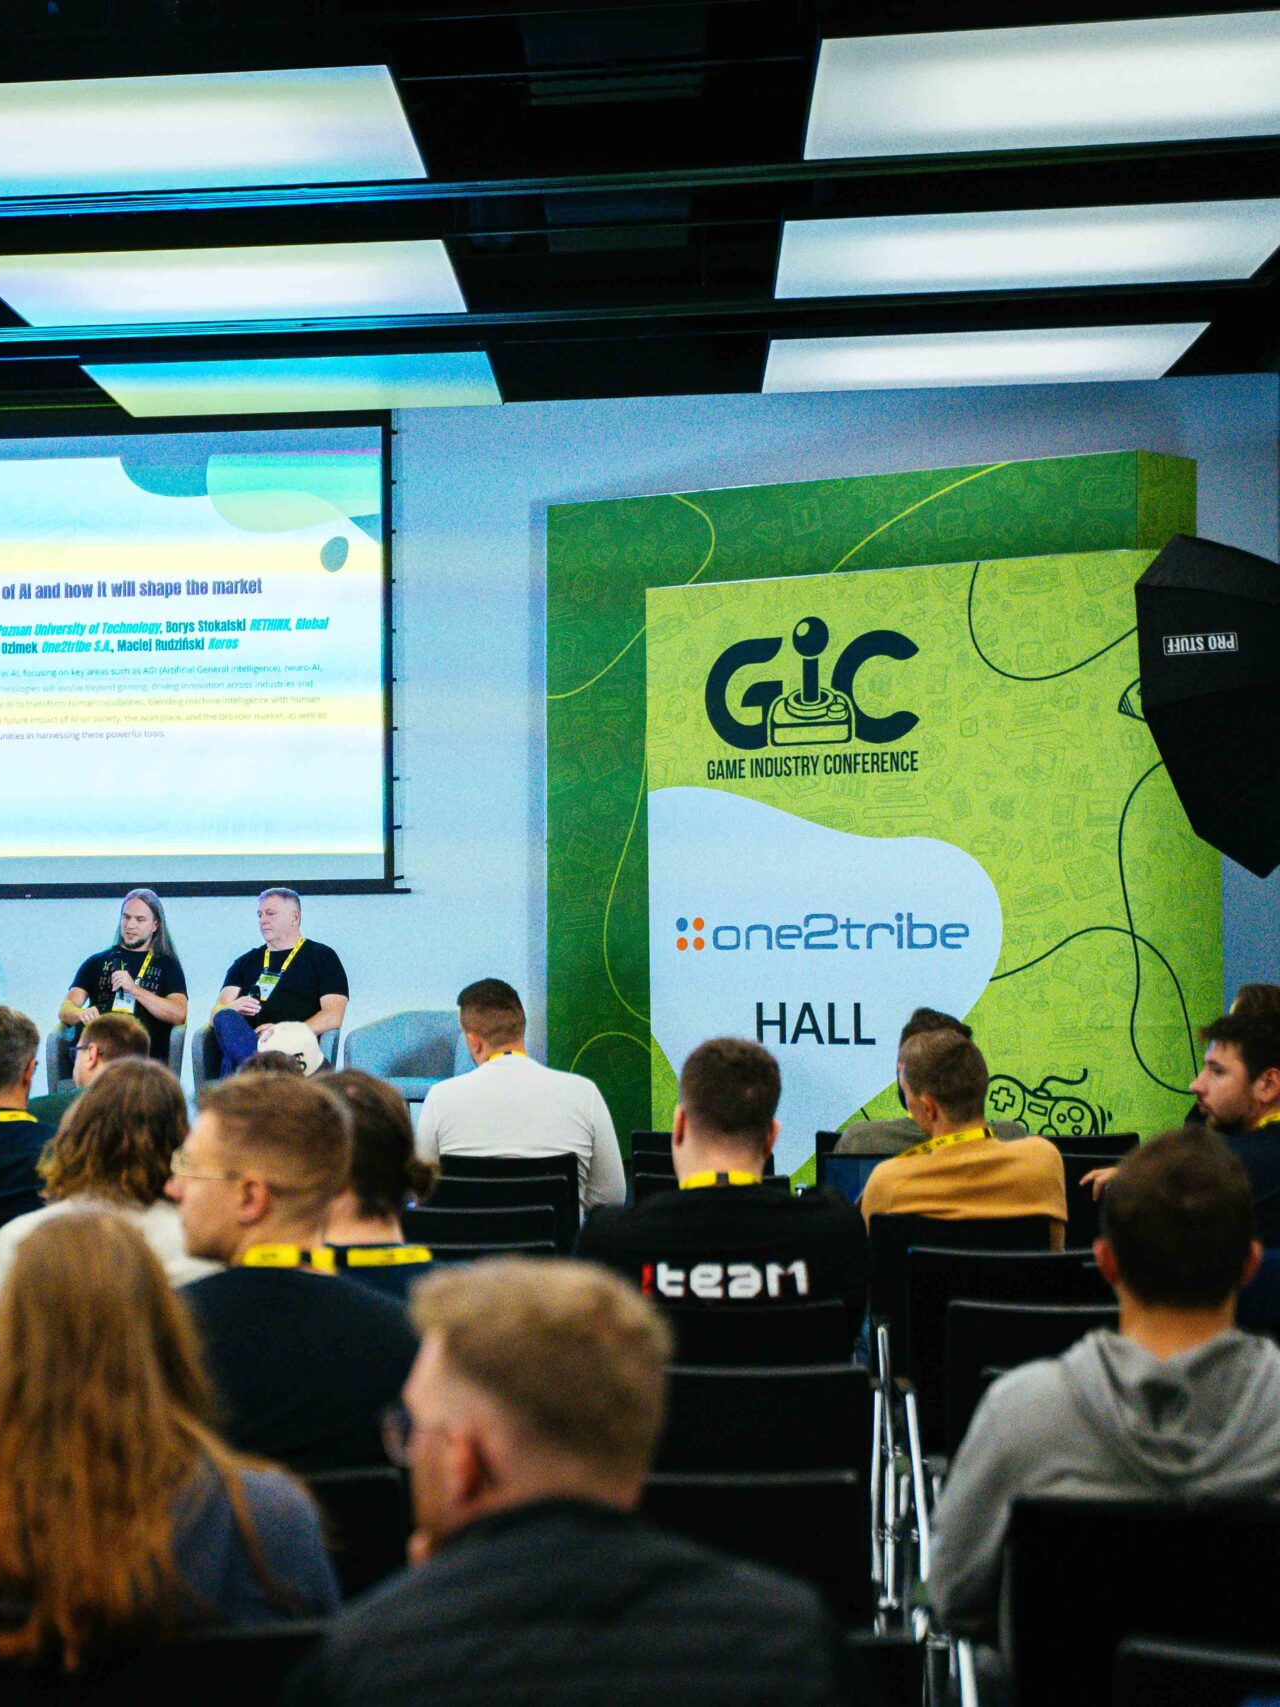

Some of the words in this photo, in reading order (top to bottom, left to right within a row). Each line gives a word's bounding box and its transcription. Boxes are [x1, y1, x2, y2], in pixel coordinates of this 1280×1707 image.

[2, 584, 16, 600] of
[19, 584, 32, 599] AI
[35, 583, 60, 599] and
[64, 582, 93, 598] how
[98, 582, 107, 597] it
[111, 581, 136, 597] will
[139, 580, 182, 599] shape
[185, 580, 208, 595] the
[212, 578, 263, 594] market
[34, 622, 86, 638] University
[88, 622, 99, 634] of
[102, 621, 163, 637] Technology,
[166, 620, 195, 635] Borys
[198, 619, 246, 632] Stokalski
[295, 617, 329, 630] Global
[1, 641, 38, 654] Ozimek
[42, 640, 91, 653] One2tribe
[117, 639, 152, 654] Maciej
[1167, 637, 1204, 653] STUFF
[1208, 635, 1235, 650] PRO
[23, 668, 57, 679] focusing
[71, 668, 85, 678] key
[110, 667, 129, 675] such
[197, 665, 229, 673] General
[26, 731, 34, 739] in
[36, 731, 80, 742] harnessing
[82, 730, 104, 738] these
[106, 730, 142, 741] powerful
[708, 759, 746, 780] GAME
[750, 755, 820, 778] INDUSTRY
[824, 751, 919, 775] CONFERENCE
[712, 912, 970, 950] one2tribe
[756, 1002, 876, 1045] HALL
